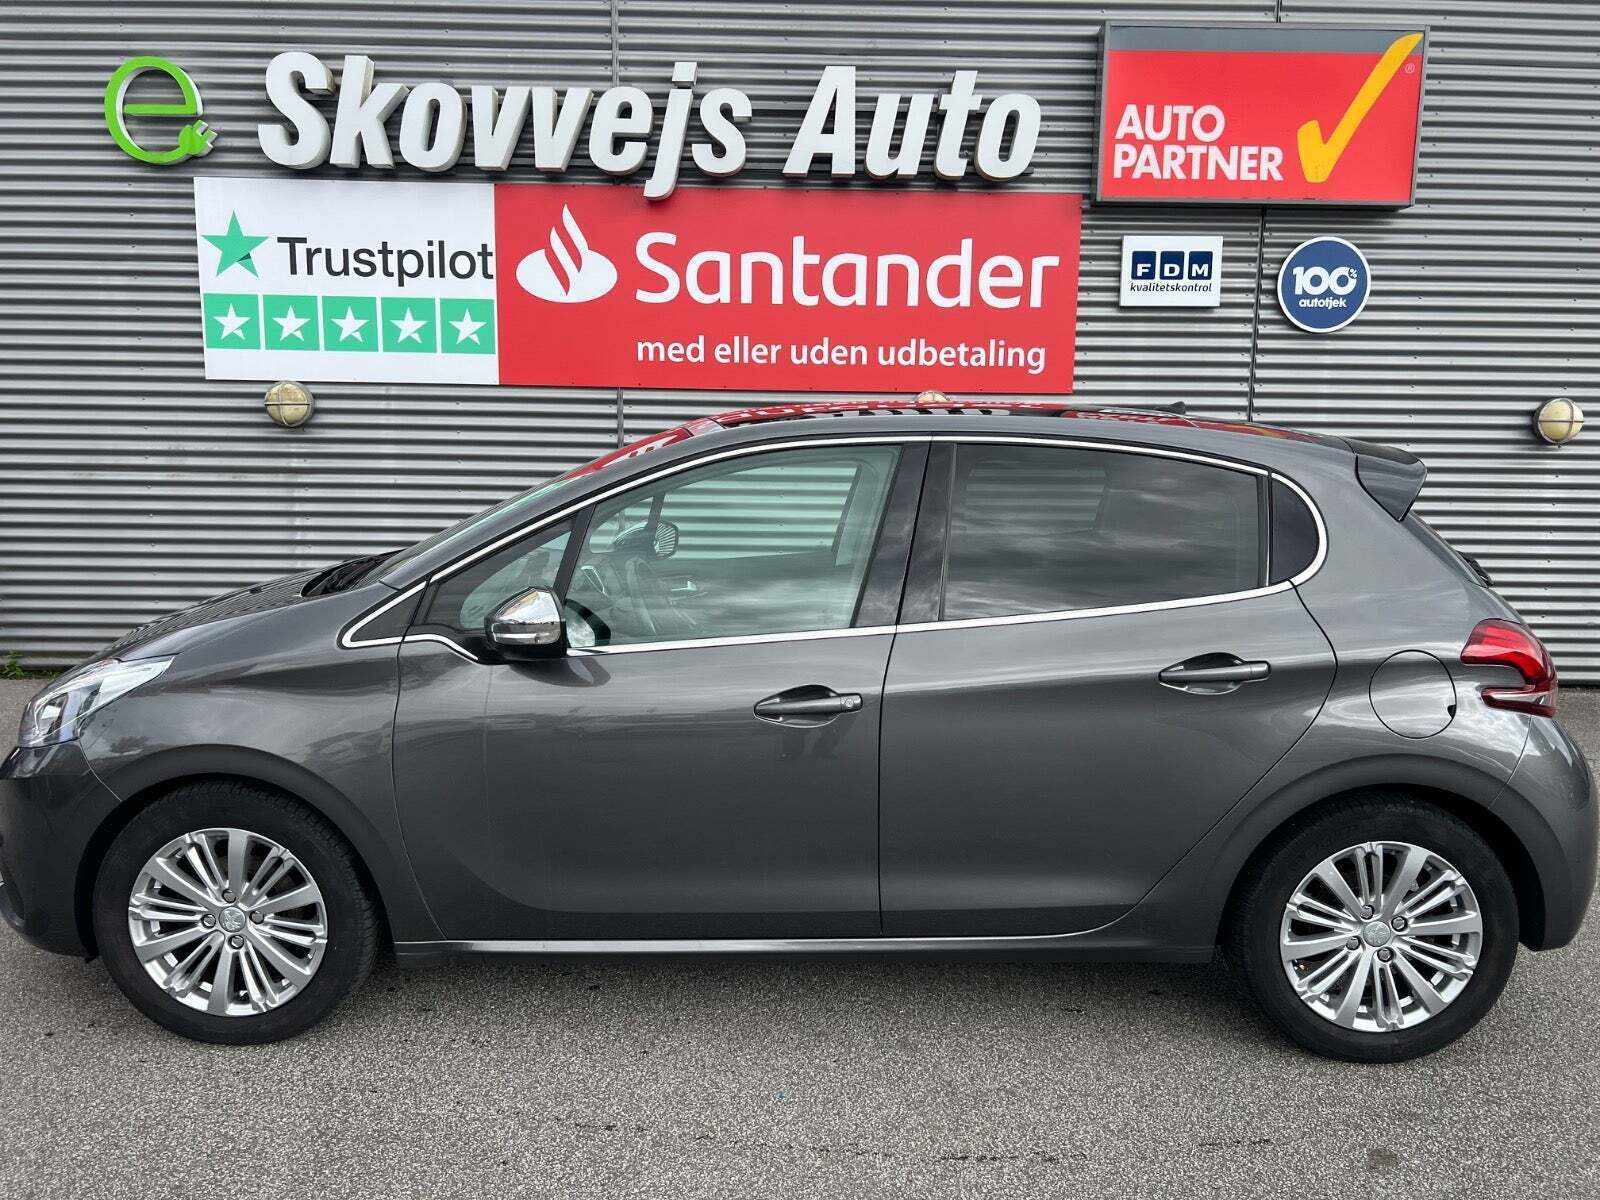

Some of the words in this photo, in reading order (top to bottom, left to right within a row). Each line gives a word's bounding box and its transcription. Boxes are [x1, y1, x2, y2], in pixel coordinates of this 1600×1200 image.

[258, 51, 752, 200] Skovvejs
[782, 65, 1042, 182] Auto
[1114, 104, 1226, 142] AUTO
[1113, 144, 1284, 181] PARTNER
[277, 236, 494, 287] Trustpilot
[635, 231, 1060, 308] Santander
[1130, 282, 1213, 294] kvalitetskontrol
[1299, 296, 1347, 310] autotjek
[636, 335, 705, 364] med
[714, 336, 782, 365] eller
[790, 337, 868, 366] uden
[877, 339, 1046, 375] udbetaling
